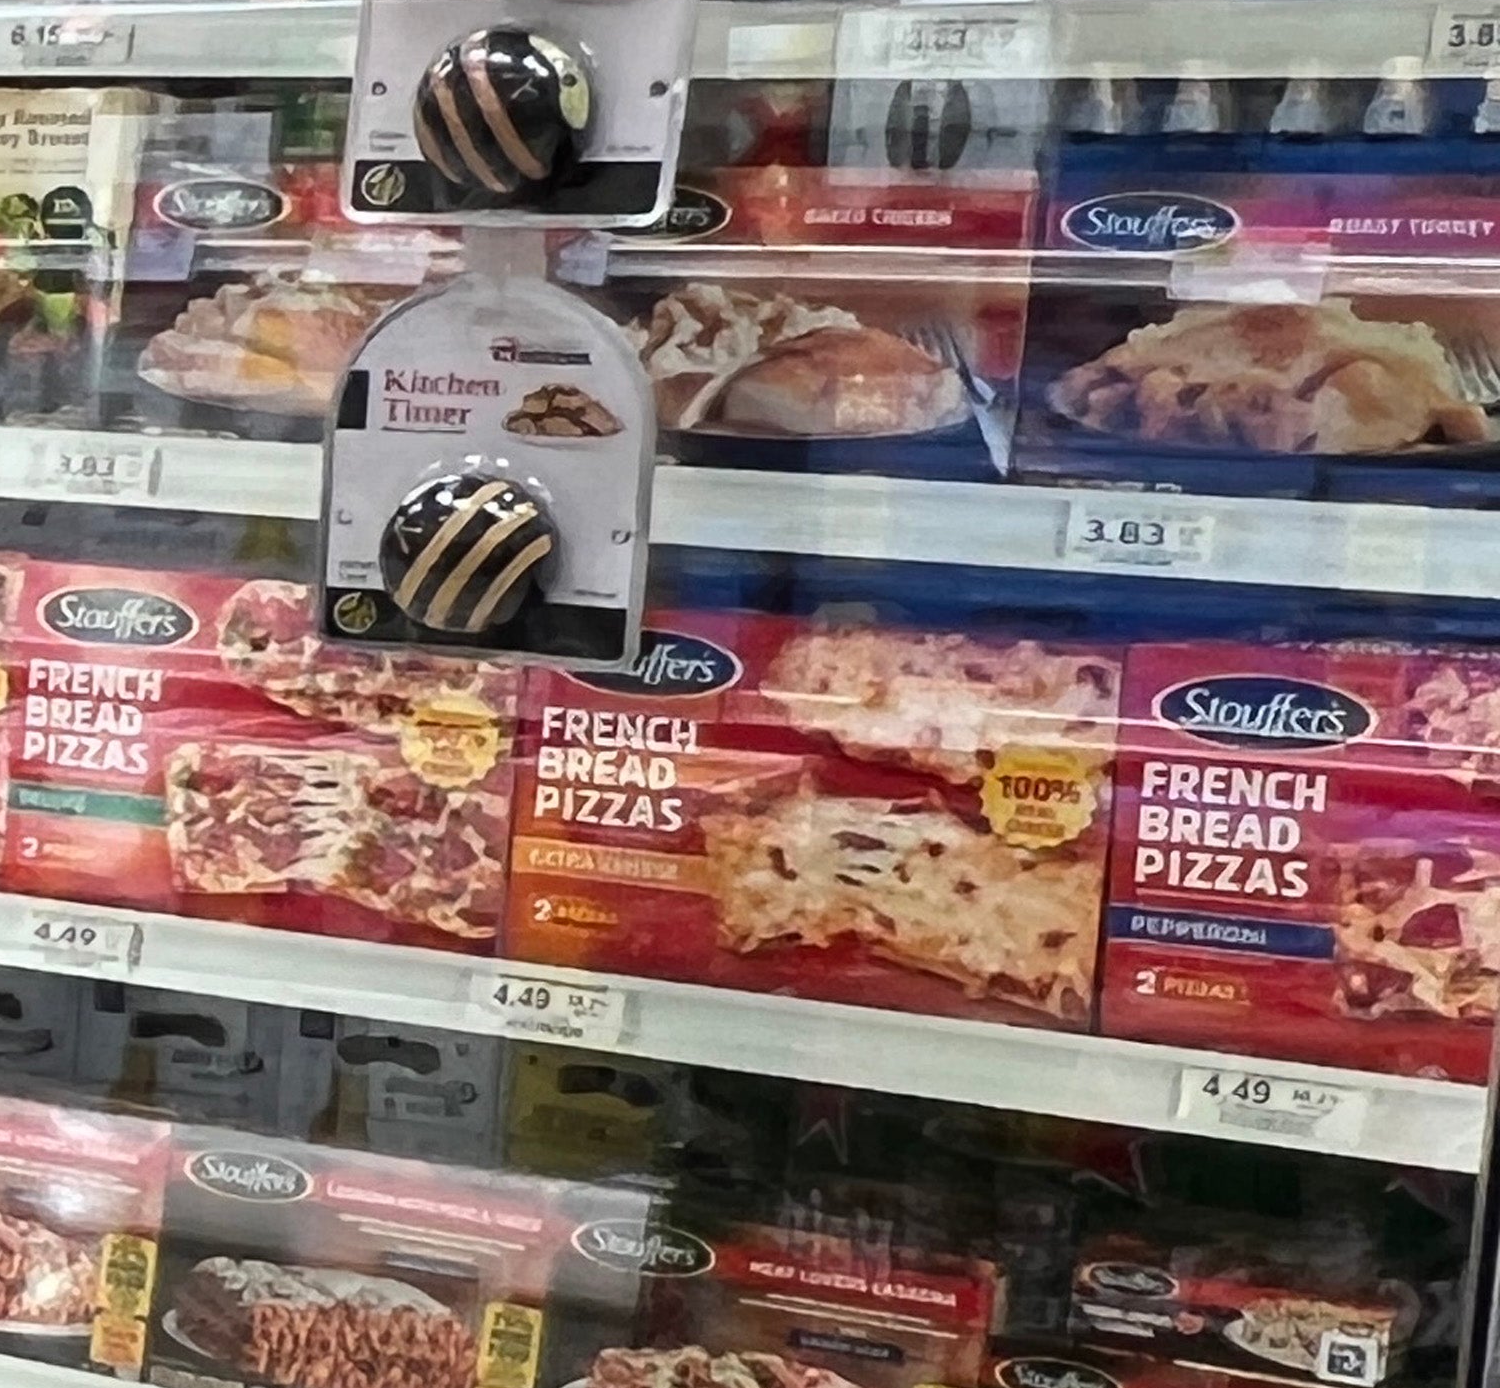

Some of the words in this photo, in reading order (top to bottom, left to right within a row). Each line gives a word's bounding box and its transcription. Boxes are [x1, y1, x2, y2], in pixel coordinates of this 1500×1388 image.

[383, 367, 501, 399] Kitchen
[383, 398, 472, 426] Timer
[52, 592, 180, 641] Stouffer's
[26, 656, 165, 704] FRENCH
[632, 641, 718, 687] uffer's
[23, 693, 144, 738] BREAD
[540, 704, 702, 757] FRENCH
[1179, 686, 1348, 738] Stouffer's
[21, 731, 151, 775] PIZZAS
[536, 744, 678, 792] BREAD
[1140, 760, 1329, 814] FRENCH
[532, 787, 684, 835] PIZZAS
[1137, 804, 1302, 854] BREAD
[21, 836, 39, 859] 2
[1133, 845, 1309, 899] PIZZAS
[532, 898, 552, 923] 2
[1130, 913, 1267, 946] PEPPERONI
[492, 983, 552, 1012] 4.49
[1135, 969, 1157, 996] 2
[1201, 1073, 1272, 1106] 4.49
